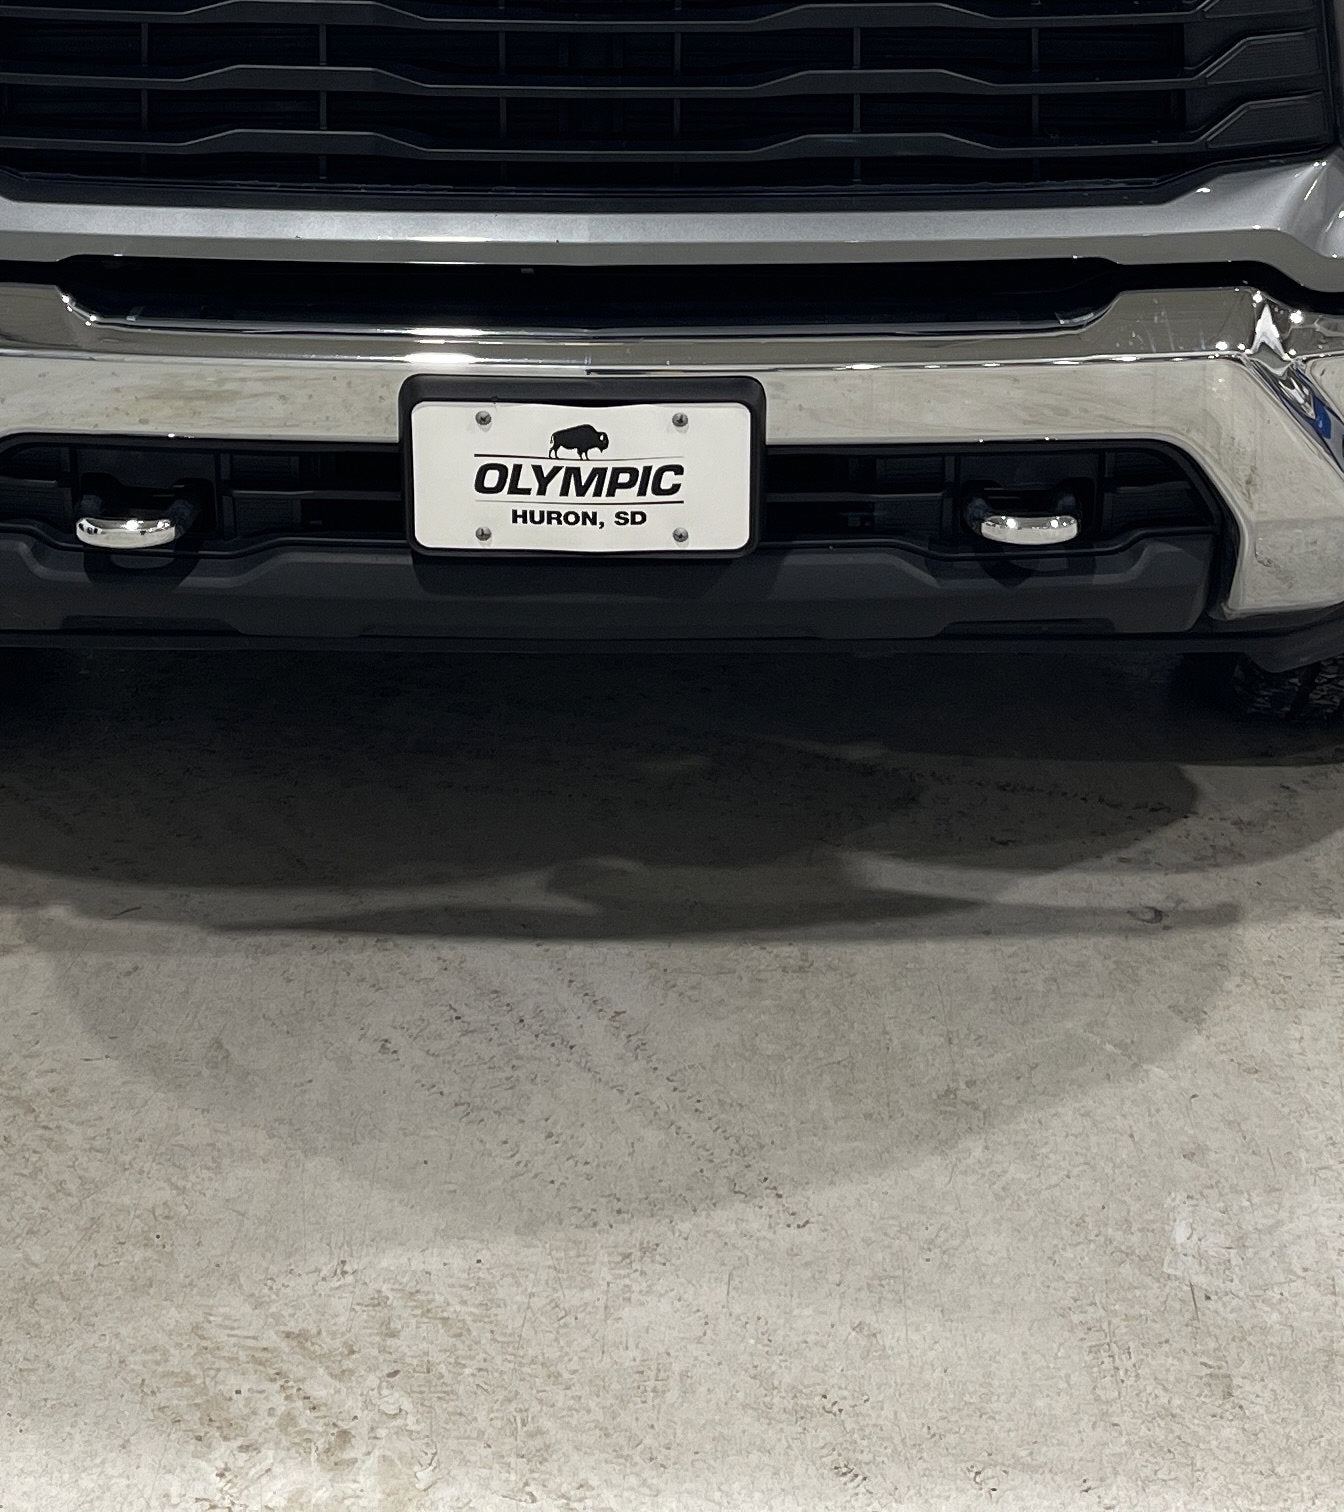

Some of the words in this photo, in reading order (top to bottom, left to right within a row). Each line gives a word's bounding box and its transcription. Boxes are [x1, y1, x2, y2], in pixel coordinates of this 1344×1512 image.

[474, 462, 685, 498] OLYMPIC
[511, 509, 605, 530] HURON,
[614, 510, 647, 526] SD
